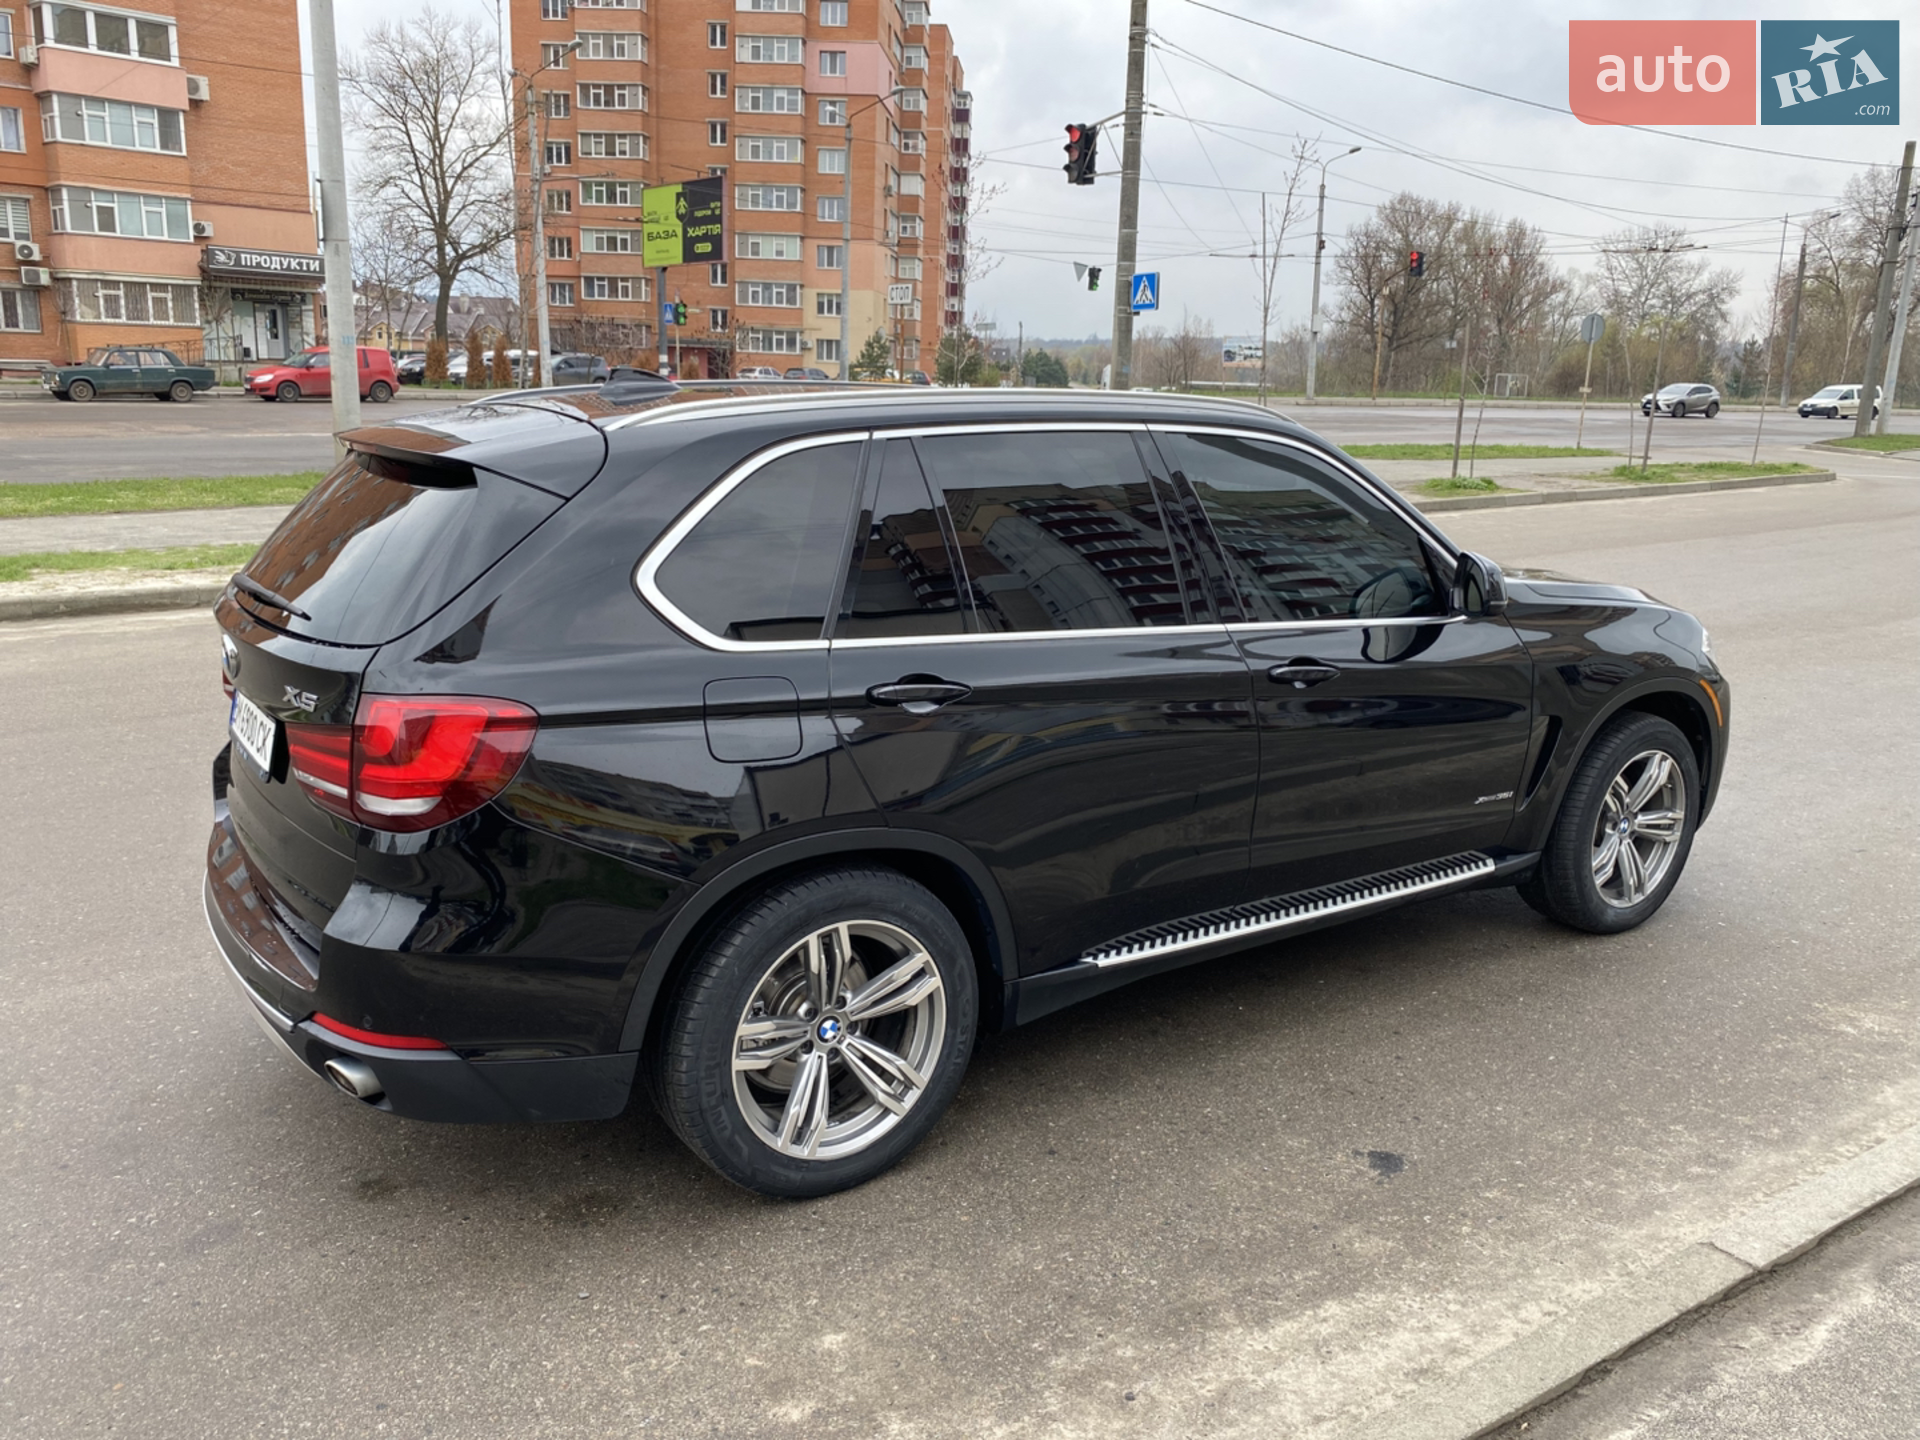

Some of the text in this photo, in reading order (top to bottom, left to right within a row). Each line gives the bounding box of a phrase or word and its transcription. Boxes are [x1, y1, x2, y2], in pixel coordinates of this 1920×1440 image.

[647, 229, 678, 241] БАЗА
[686, 224, 721, 237] ХАРТІЯ
[240, 253, 320, 272] ПРОДУКТИ
[890, 286, 910, 301] СТОП
[282, 684, 319, 713] X5
